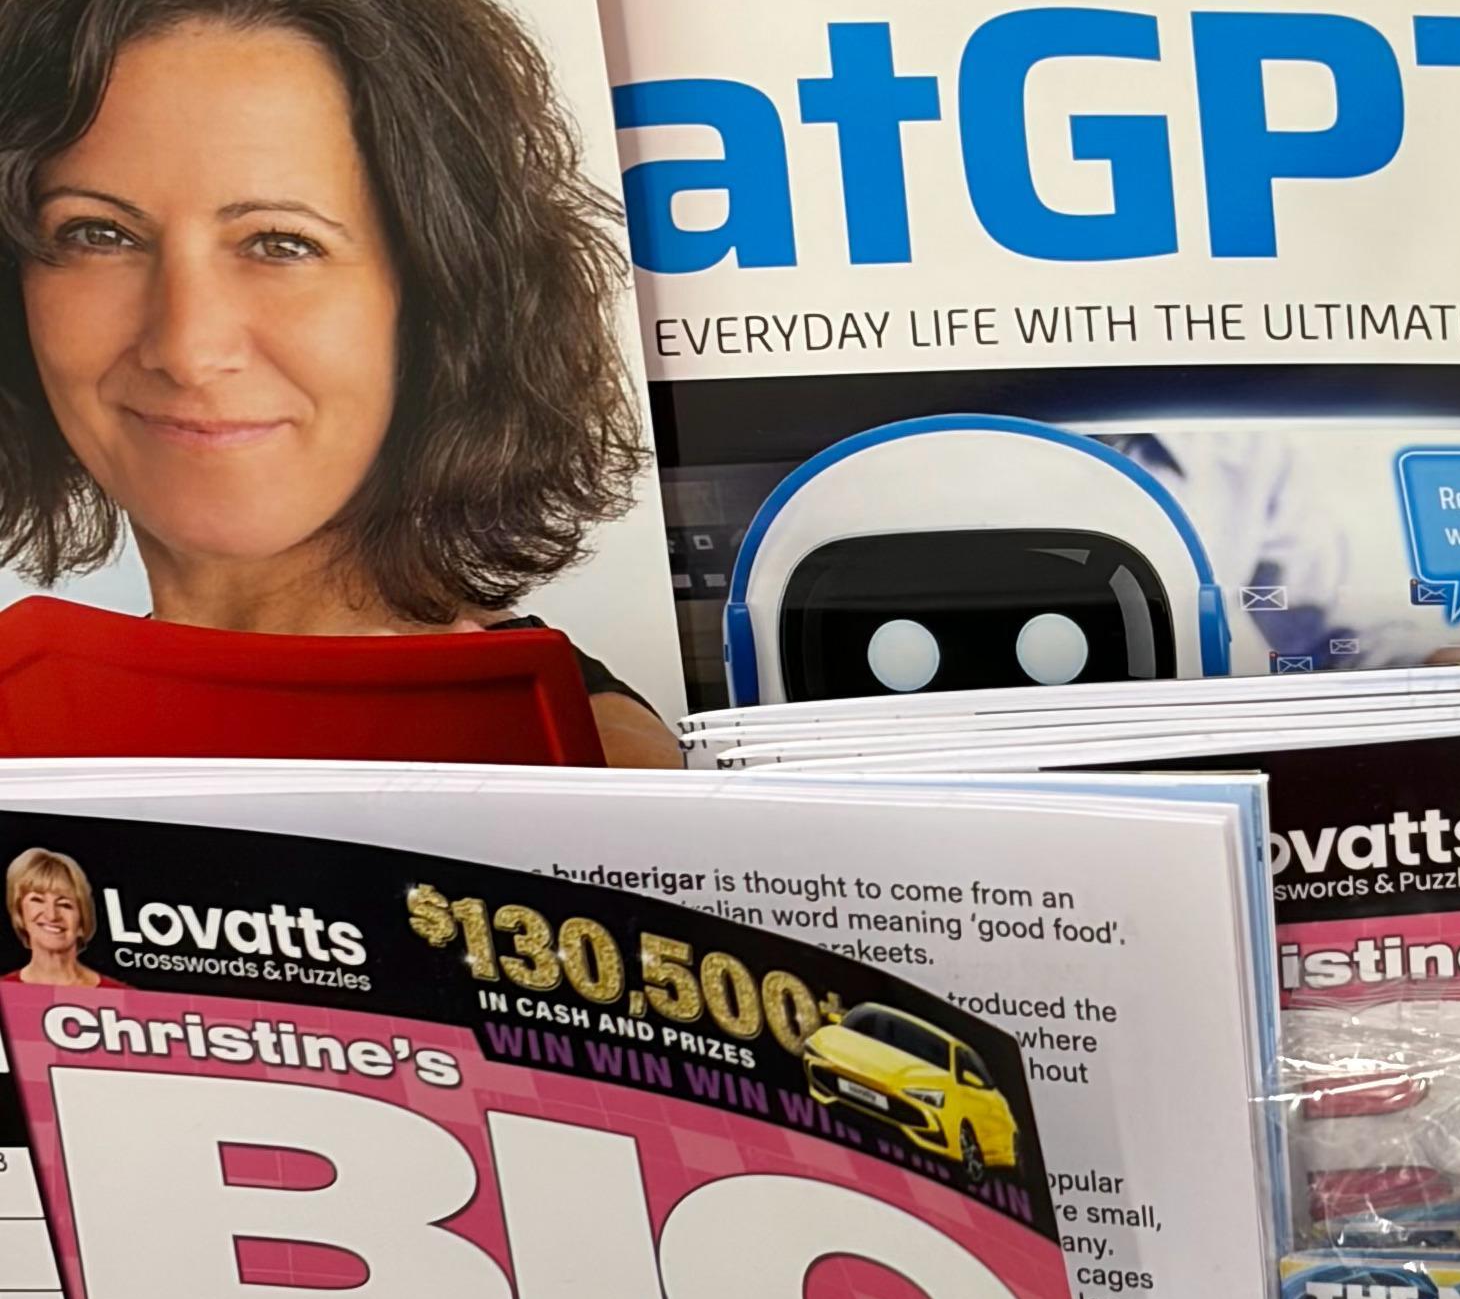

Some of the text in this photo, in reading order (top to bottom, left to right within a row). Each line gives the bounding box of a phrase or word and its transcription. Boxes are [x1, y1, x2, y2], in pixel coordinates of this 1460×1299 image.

[654, 311, 891, 357] EVERYDAY
[909, 308, 998, 347] LIFE
[1014, 305, 1137, 344] WITH
[1153, 304, 1245, 342] THE
[714, 868, 1075, 910] is thought to come from an
[103, 887, 367, 967] Lovatts
[771, 904, 839, 930] word
[847, 911, 963, 941] meaning
[113, 947, 373, 993] Crosswords Puzzles
[477, 989, 757, 1070] IN CASH AND PRIZES
[1073, 998, 1118, 1024] the
[42, 1004, 464, 1090] Christine's
[484, 1022, 769, 1116] WIN WIN WIN
[1086, 1205, 1163, 1233] small,
[1077, 1266, 1155, 1292] cages
